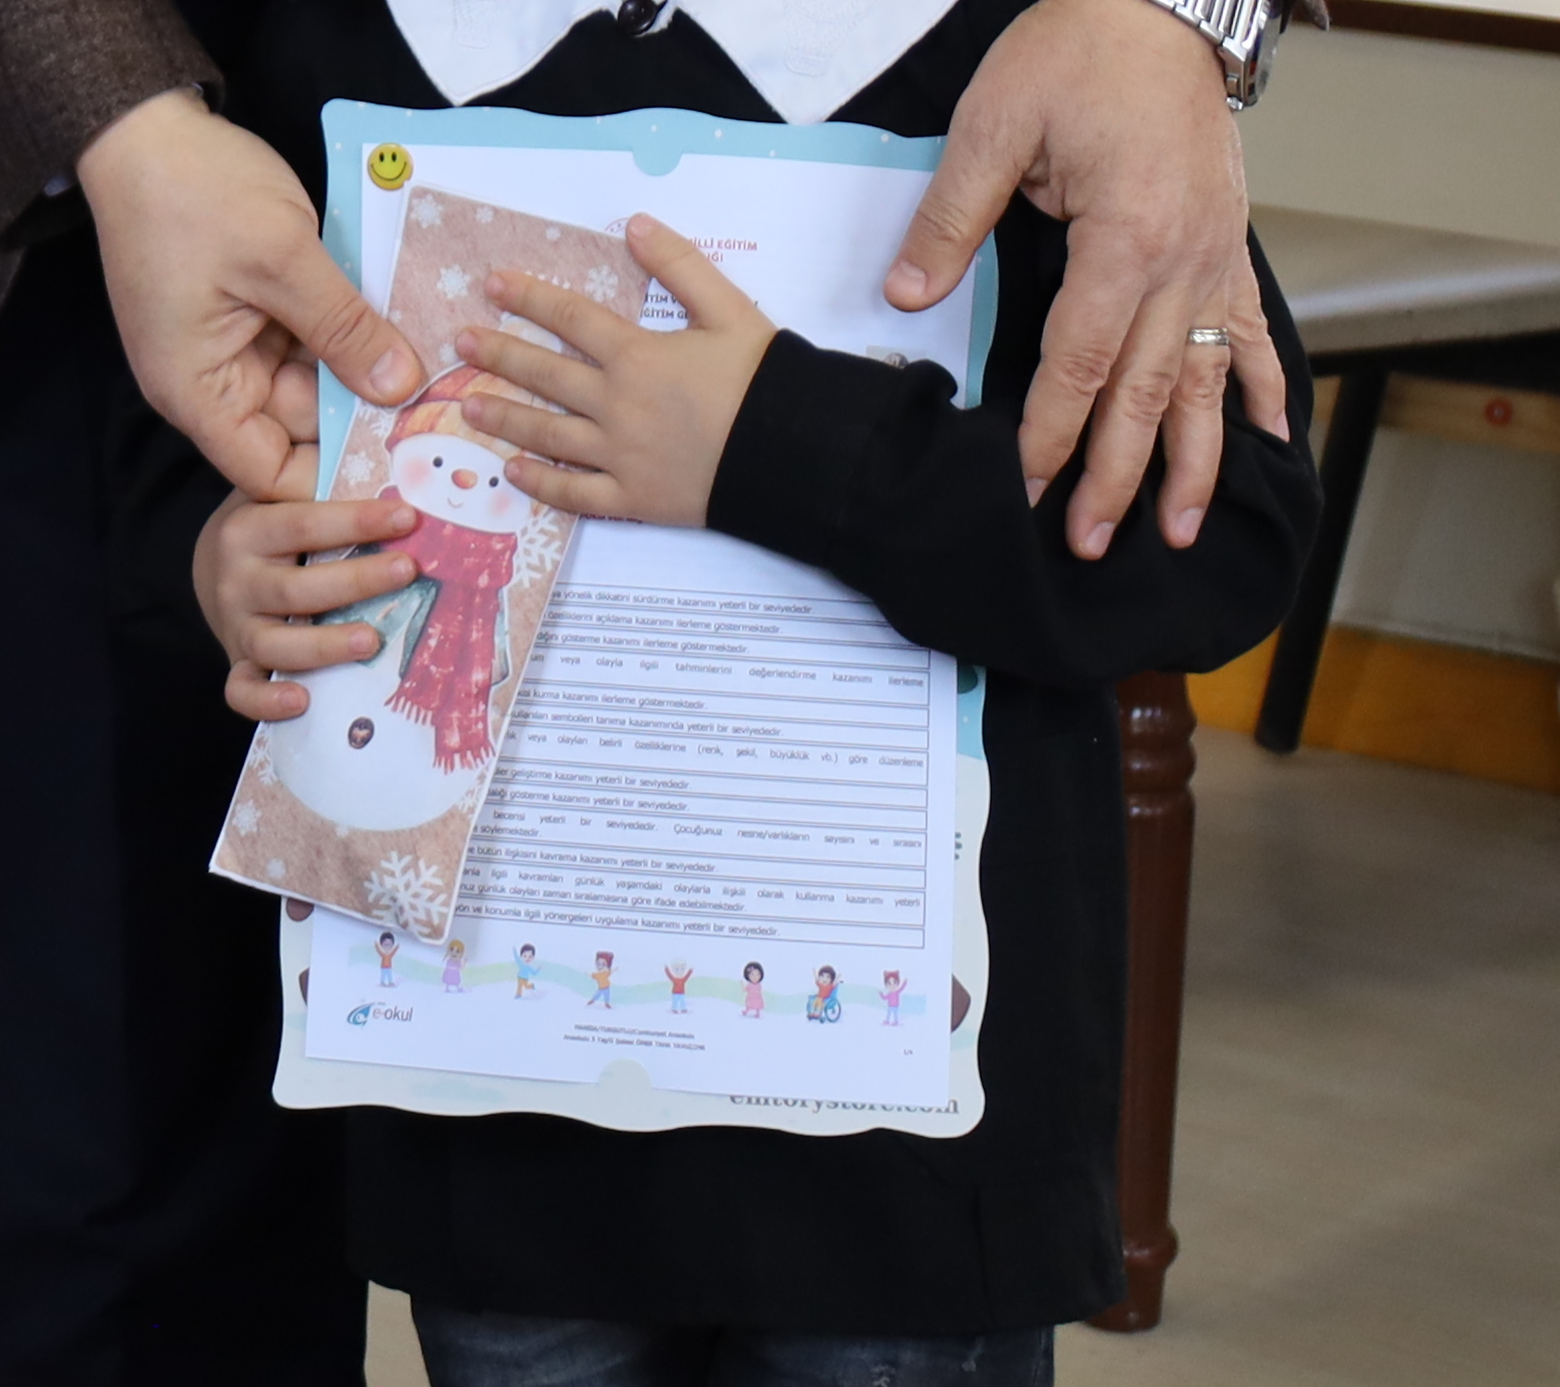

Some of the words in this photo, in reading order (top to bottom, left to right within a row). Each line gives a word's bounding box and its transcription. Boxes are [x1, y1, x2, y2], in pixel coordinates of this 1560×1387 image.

[720, 600, 746, 610] yeterli
[749, 601, 759, 611] bir
[561, 656, 580, 666] veya
[640, 660, 658, 671] ilgili
[688, 722, 714, 732] yeterli
[717, 723, 727, 733] bir
[528, 734, 546, 744] veya
[849, 755, 868, 765] göre
[596, 774, 622, 785] yeterli
[625, 776, 635, 785] bir
[594, 796, 620, 807] yeterli
[623, 798, 633, 807] bir
[540, 814, 565, 824] yeterli
[580, 816, 591, 826] bir
[621, 857, 648, 867] yeterli
[651, 859, 661, 868] bir
[491, 869, 507, 880] ilgili
[895, 899, 920, 909] yeterli
[631, 895, 651, 906] göre
[654, 897, 676, 907] ifade
[524, 909, 540, 920] ilgili
[684, 921, 711, 931] yeterli
[713, 923, 724, 932] bir
[372, 1006, 413, 1022] e-okul
